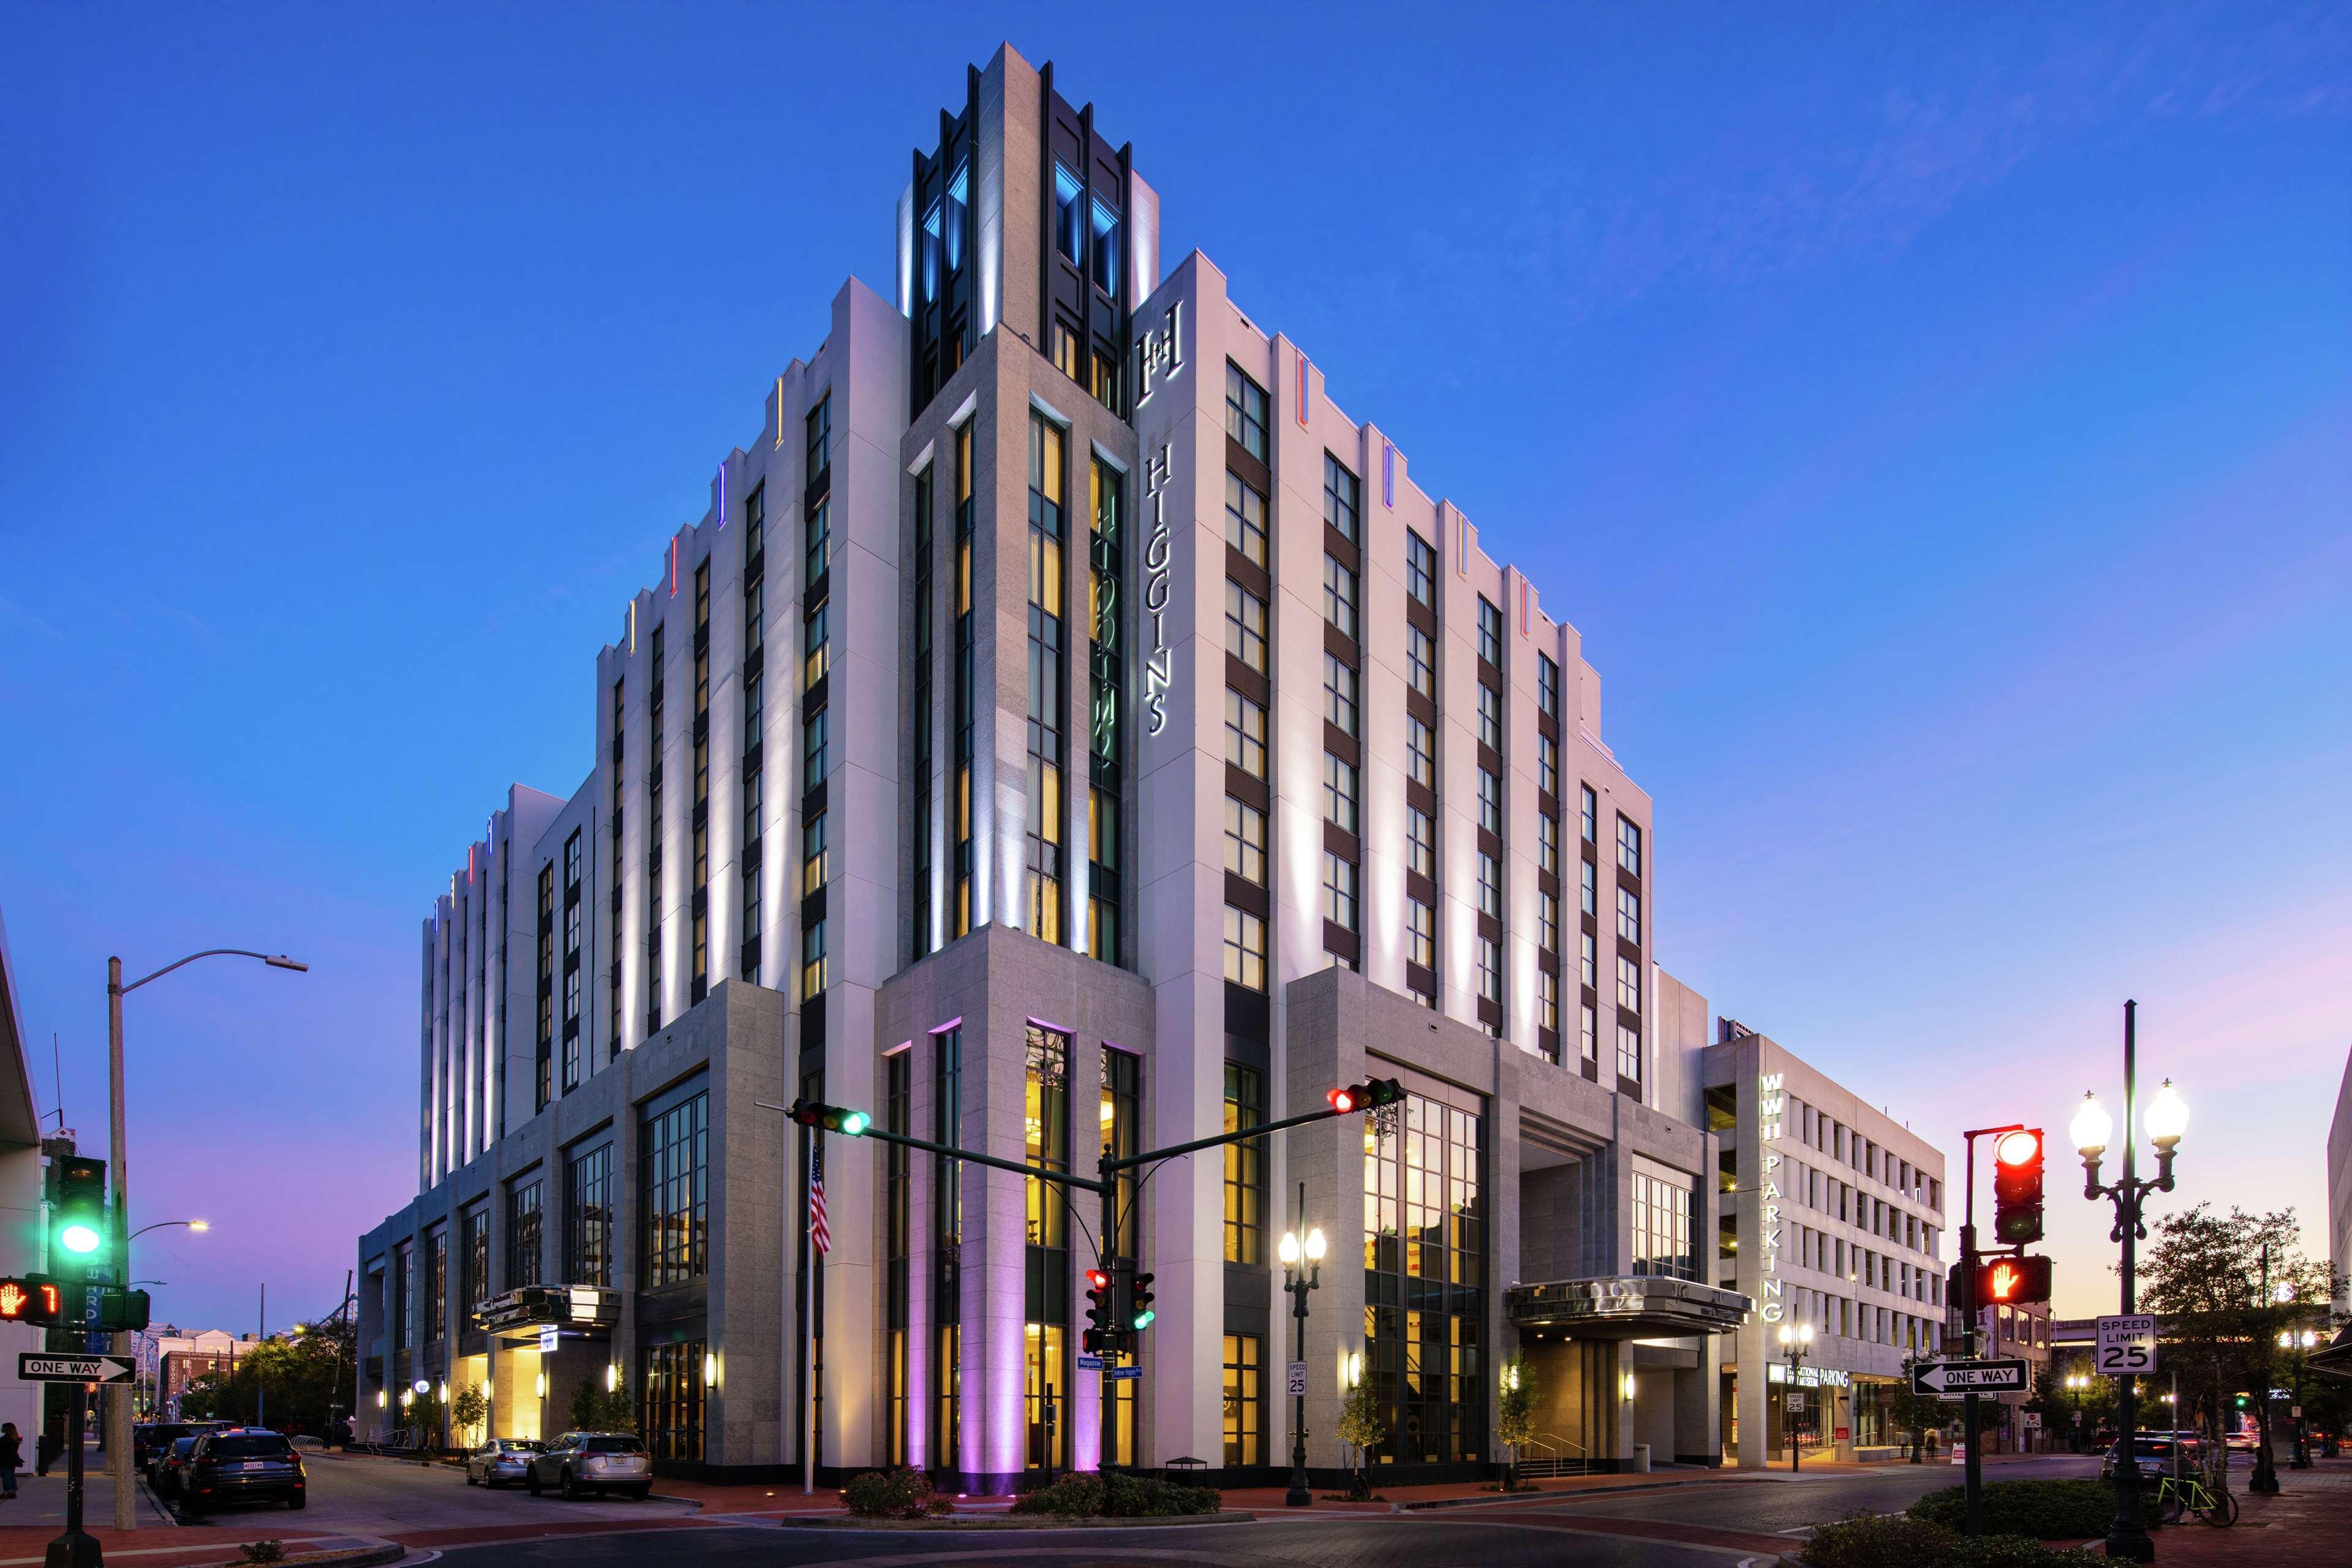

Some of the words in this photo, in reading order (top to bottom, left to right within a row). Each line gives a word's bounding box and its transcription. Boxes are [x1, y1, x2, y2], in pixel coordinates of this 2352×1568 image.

[1145, 443, 1172, 736] HIGGINS
[1762, 1073, 1784, 1140] WWII
[1762, 1156, 1784, 1322] PARKING
[2101, 1320, 2150, 1330] SPEED
[2107, 1333, 2144, 1343] LIMIT
[1080, 1359, 1101, 1367] Magazine
[2103, 1346, 2148, 1368] 25
[31, 1362, 64, 1373] ONE
[70, 1363, 101, 1374] WAY
[1800, 1376, 1819, 1387] MUSEUM
[1820, 1369, 1849, 1387] PARKING
[1947, 1371, 1975, 1384] ONE
[1982, 1370, 2013, 1382] WAY
[1290, 1380, 1304, 1392] 25
